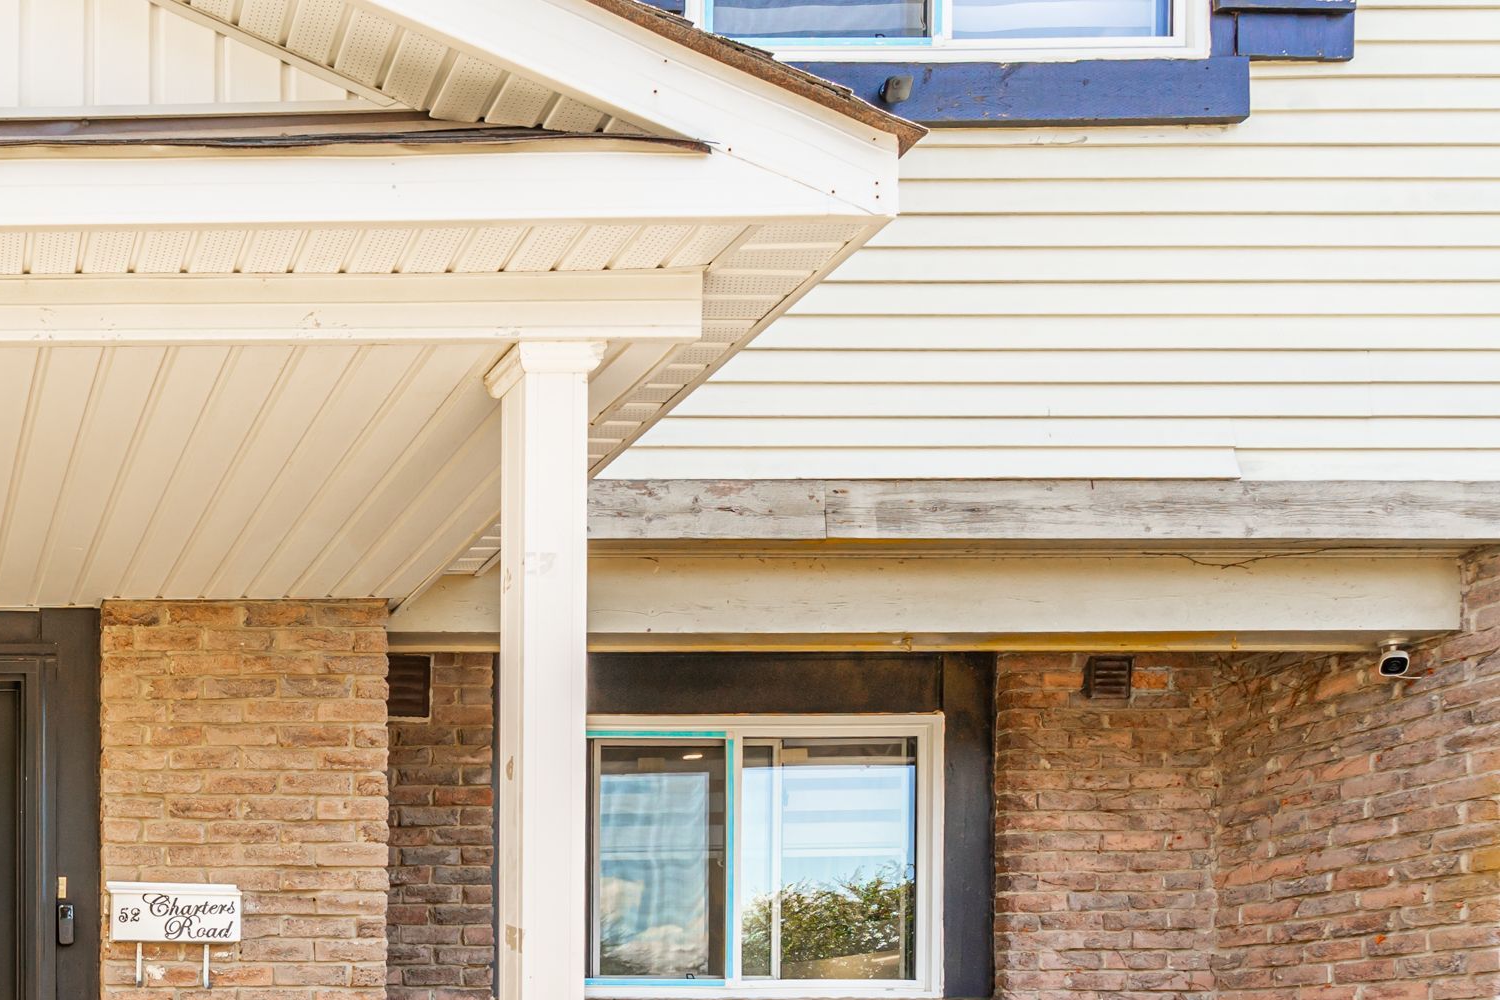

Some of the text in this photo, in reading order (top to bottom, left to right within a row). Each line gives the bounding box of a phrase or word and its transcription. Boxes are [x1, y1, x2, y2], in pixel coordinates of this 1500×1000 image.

[118, 893, 235, 923] 52 Charters
[164, 915, 234, 940] Road
